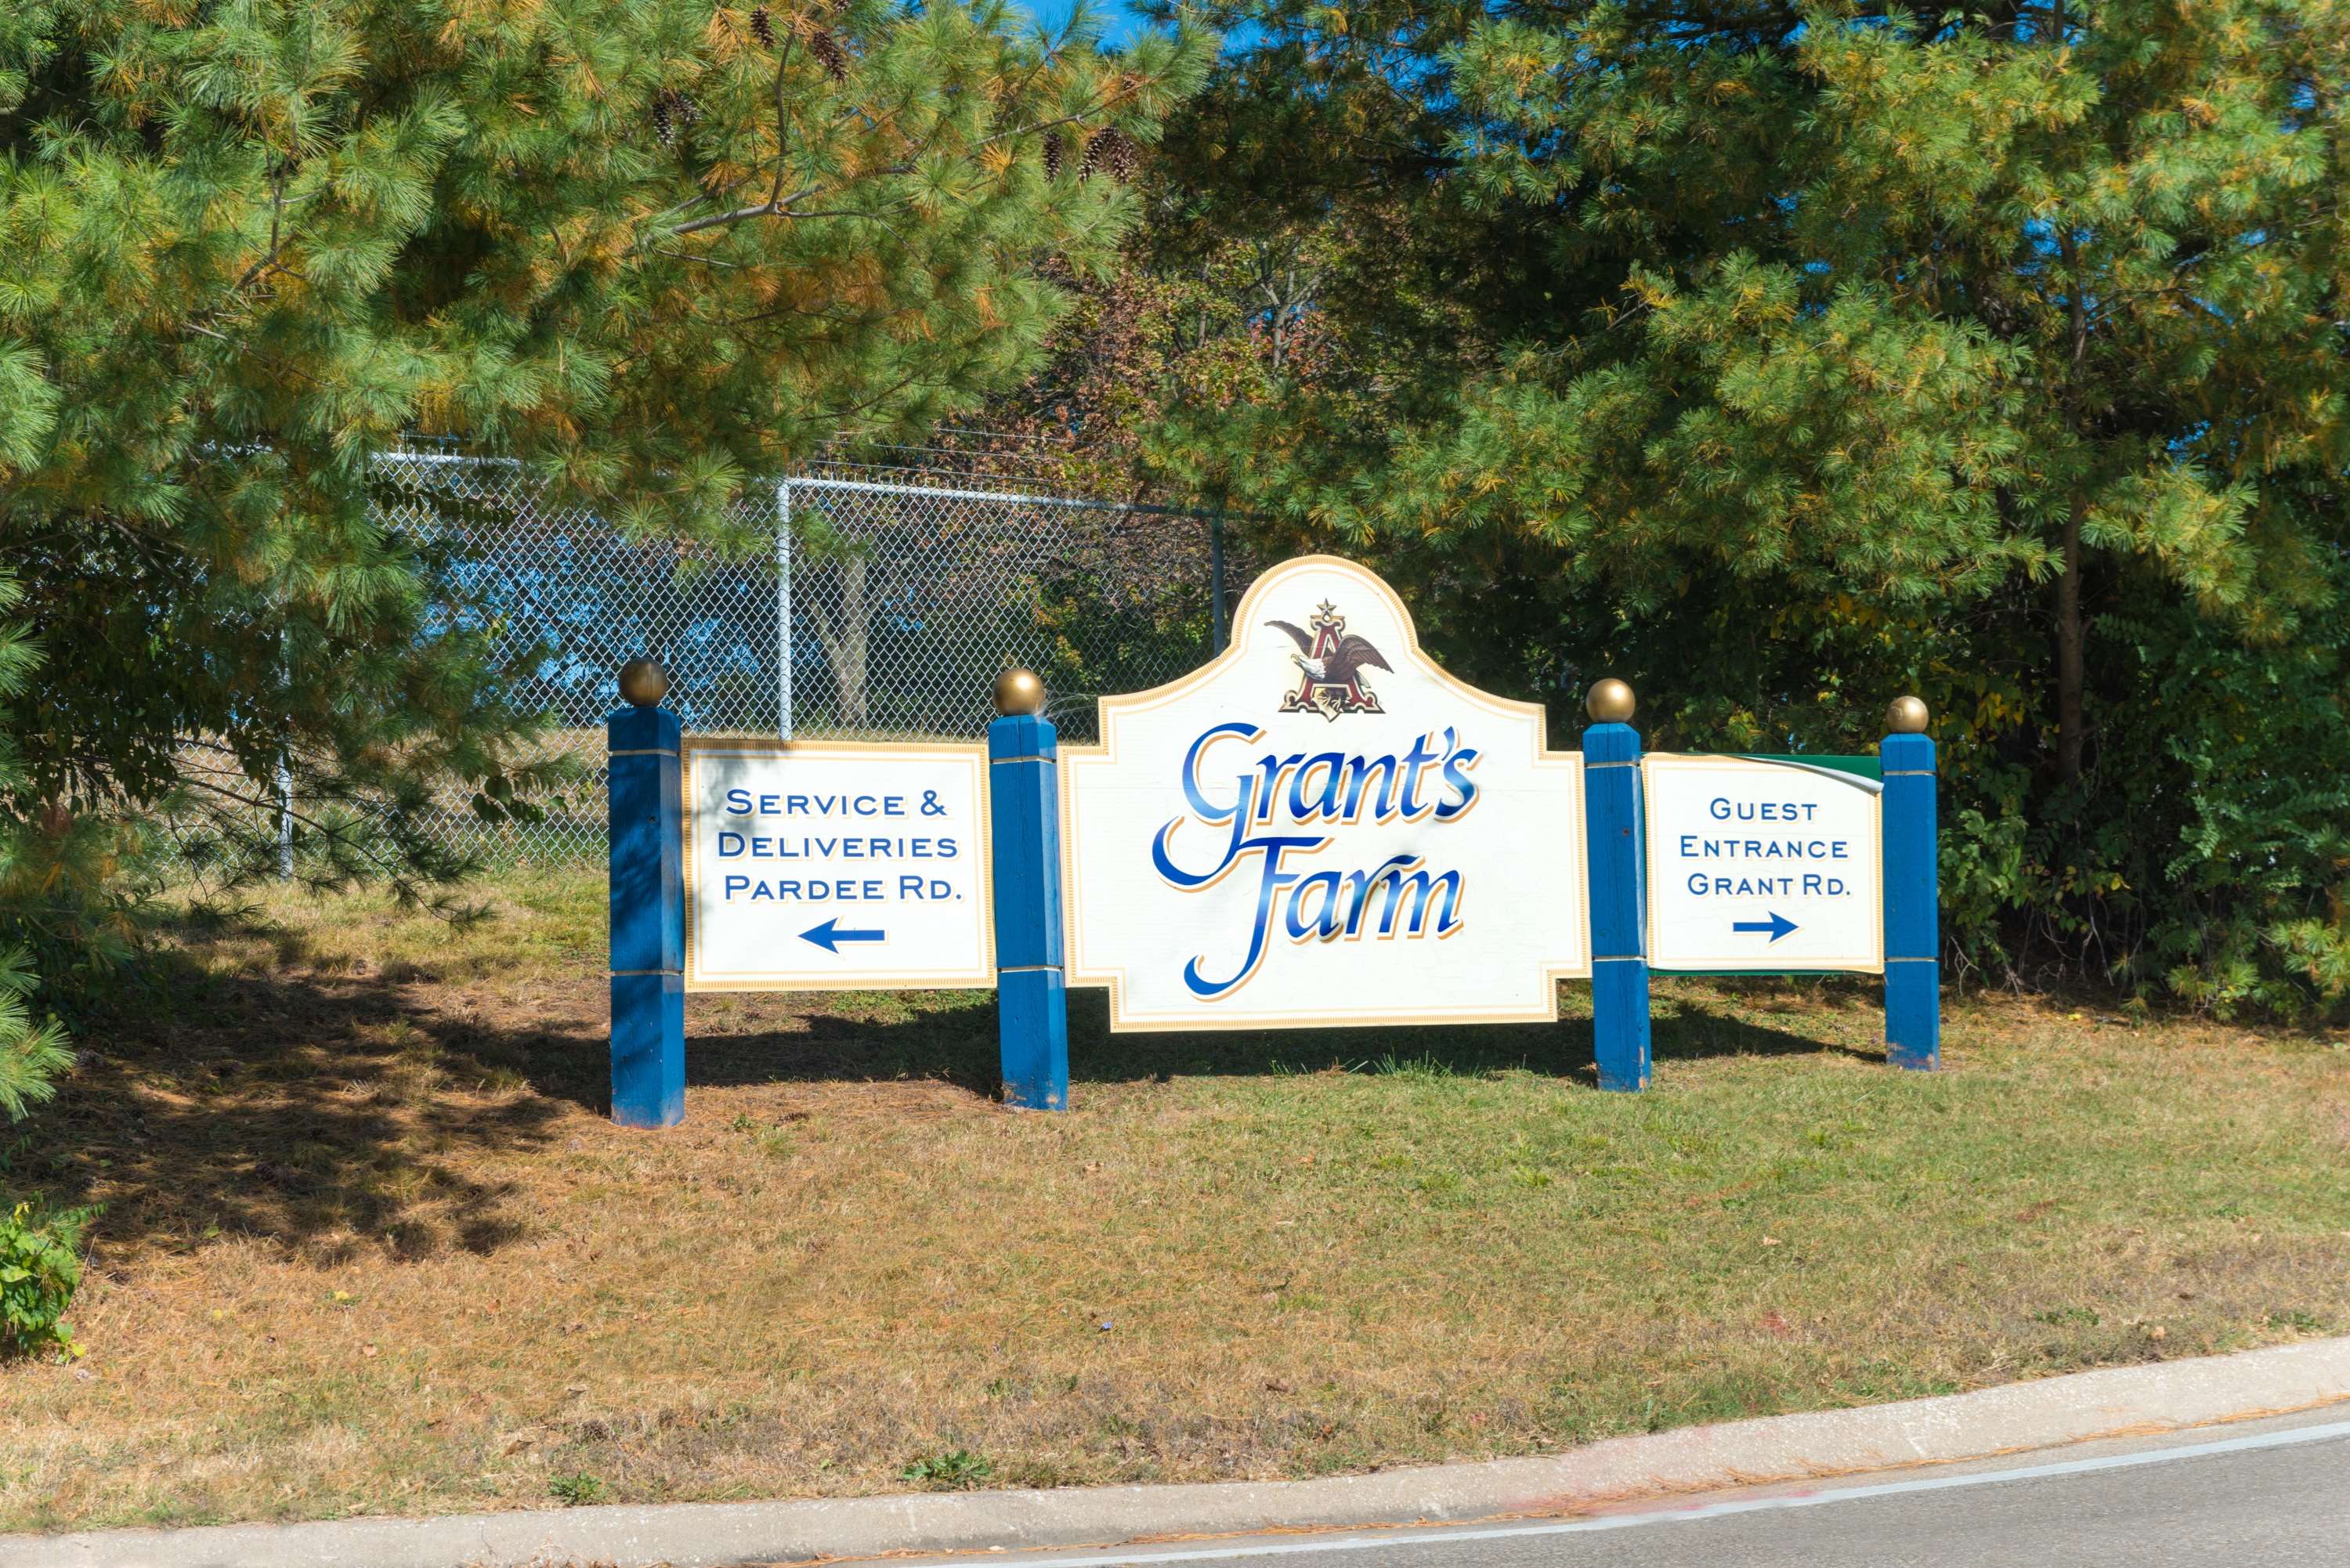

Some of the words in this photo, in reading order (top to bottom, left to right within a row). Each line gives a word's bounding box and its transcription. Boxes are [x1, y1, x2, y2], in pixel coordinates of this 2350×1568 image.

[725, 789, 906, 816] SERVICE
[920, 789, 948, 816] &
[1152, 721, 1479, 887] Grant's
[1710, 797, 1817, 821] GUEST
[718, 832, 958, 858] DELIVERIES
[1680, 835, 1849, 858] ENTRANCE
[725, 875, 884, 900] PARDEE
[1687, 873, 1794, 896] GRANT
[1183, 836, 1459, 996] Farm
